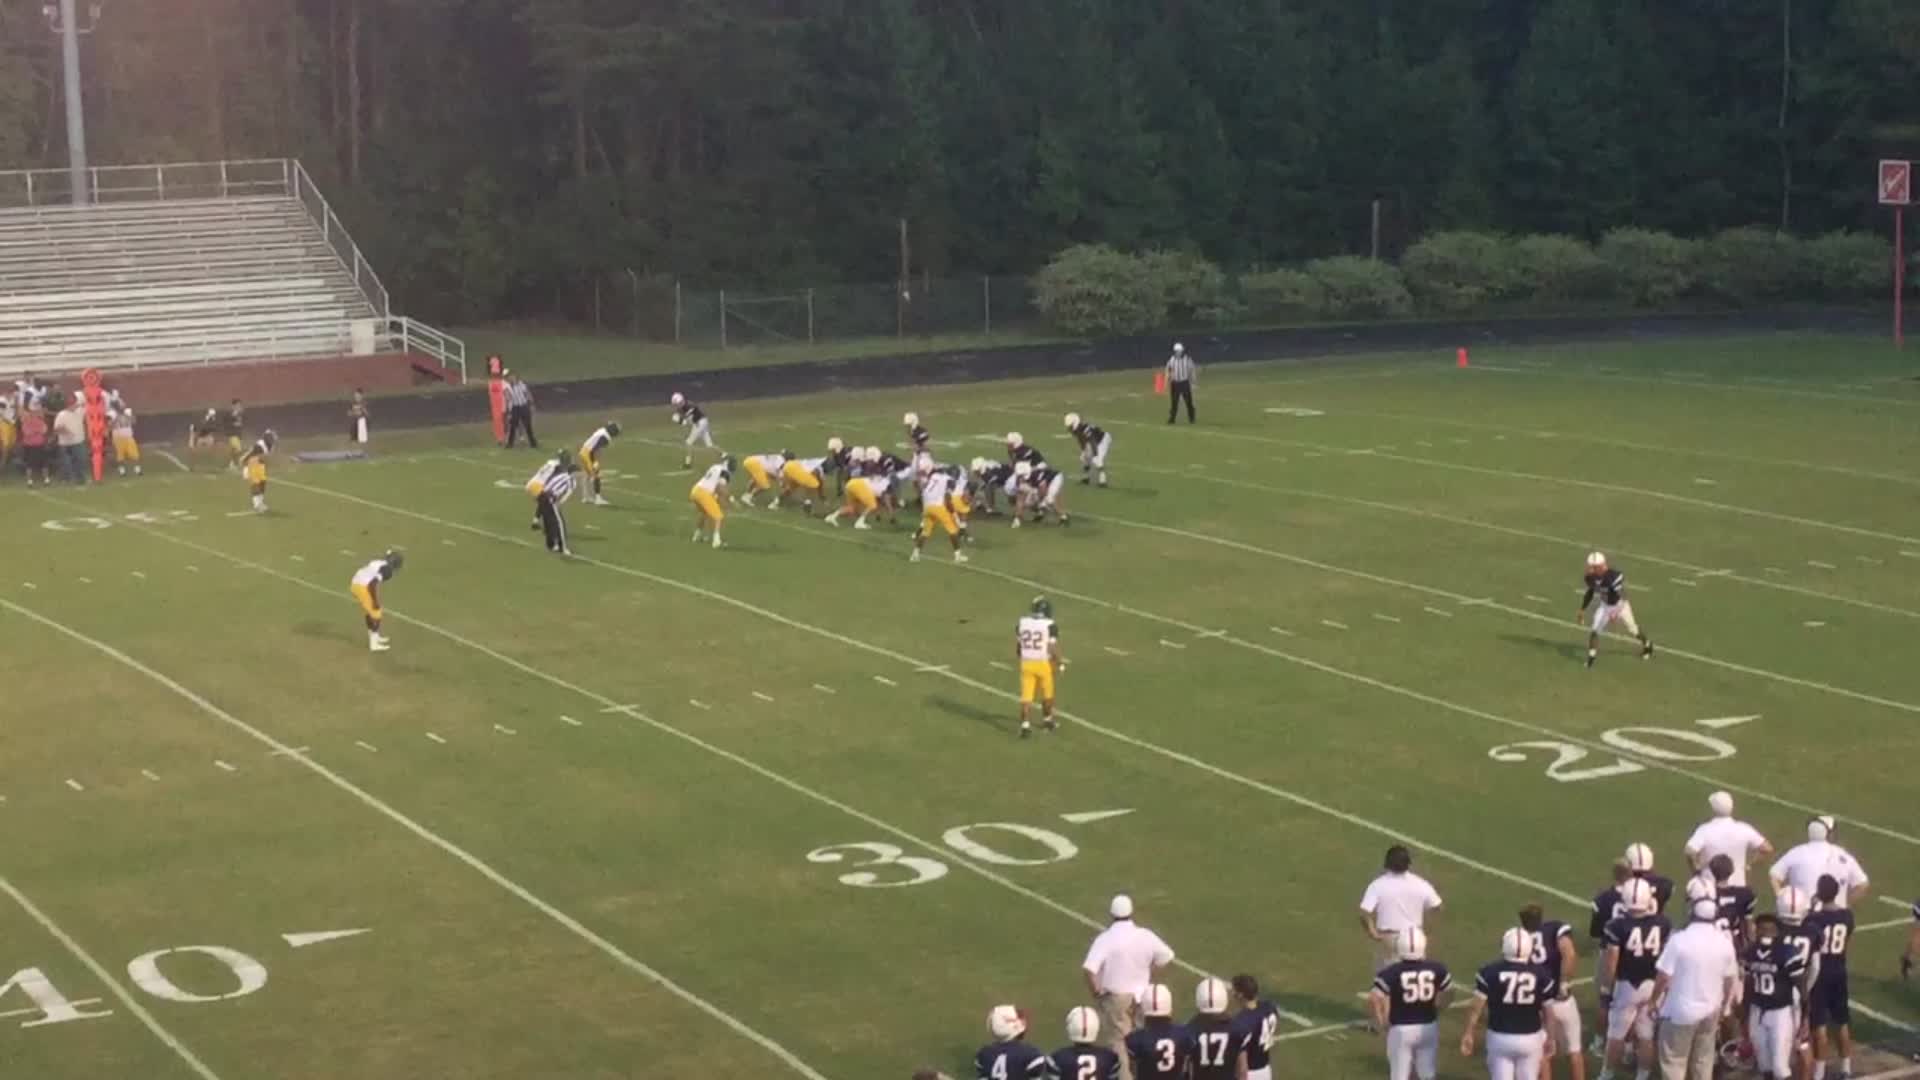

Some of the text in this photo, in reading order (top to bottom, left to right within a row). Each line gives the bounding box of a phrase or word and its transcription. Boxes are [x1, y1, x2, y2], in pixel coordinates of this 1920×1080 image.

[1021, 630, 1043, 650] 22
[1487, 726, 1737, 783] 20
[804, 822, 1079, 888] 30
[1625, 925, 1661, 957] 44
[1820, 923, 1848, 955] 18
[0, 944, 269, 1028] 40
[1400, 969, 1436, 1004] 56
[1499, 971, 1537, 1005] 72
[1751, 972, 1775, 996] 10
[1156, 1037, 1177, 1073] 3
[1198, 1031, 1230, 1067] 17
[991, 1053, 1009, 1080] 4
[1077, 1054, 1098, 1080] 2
